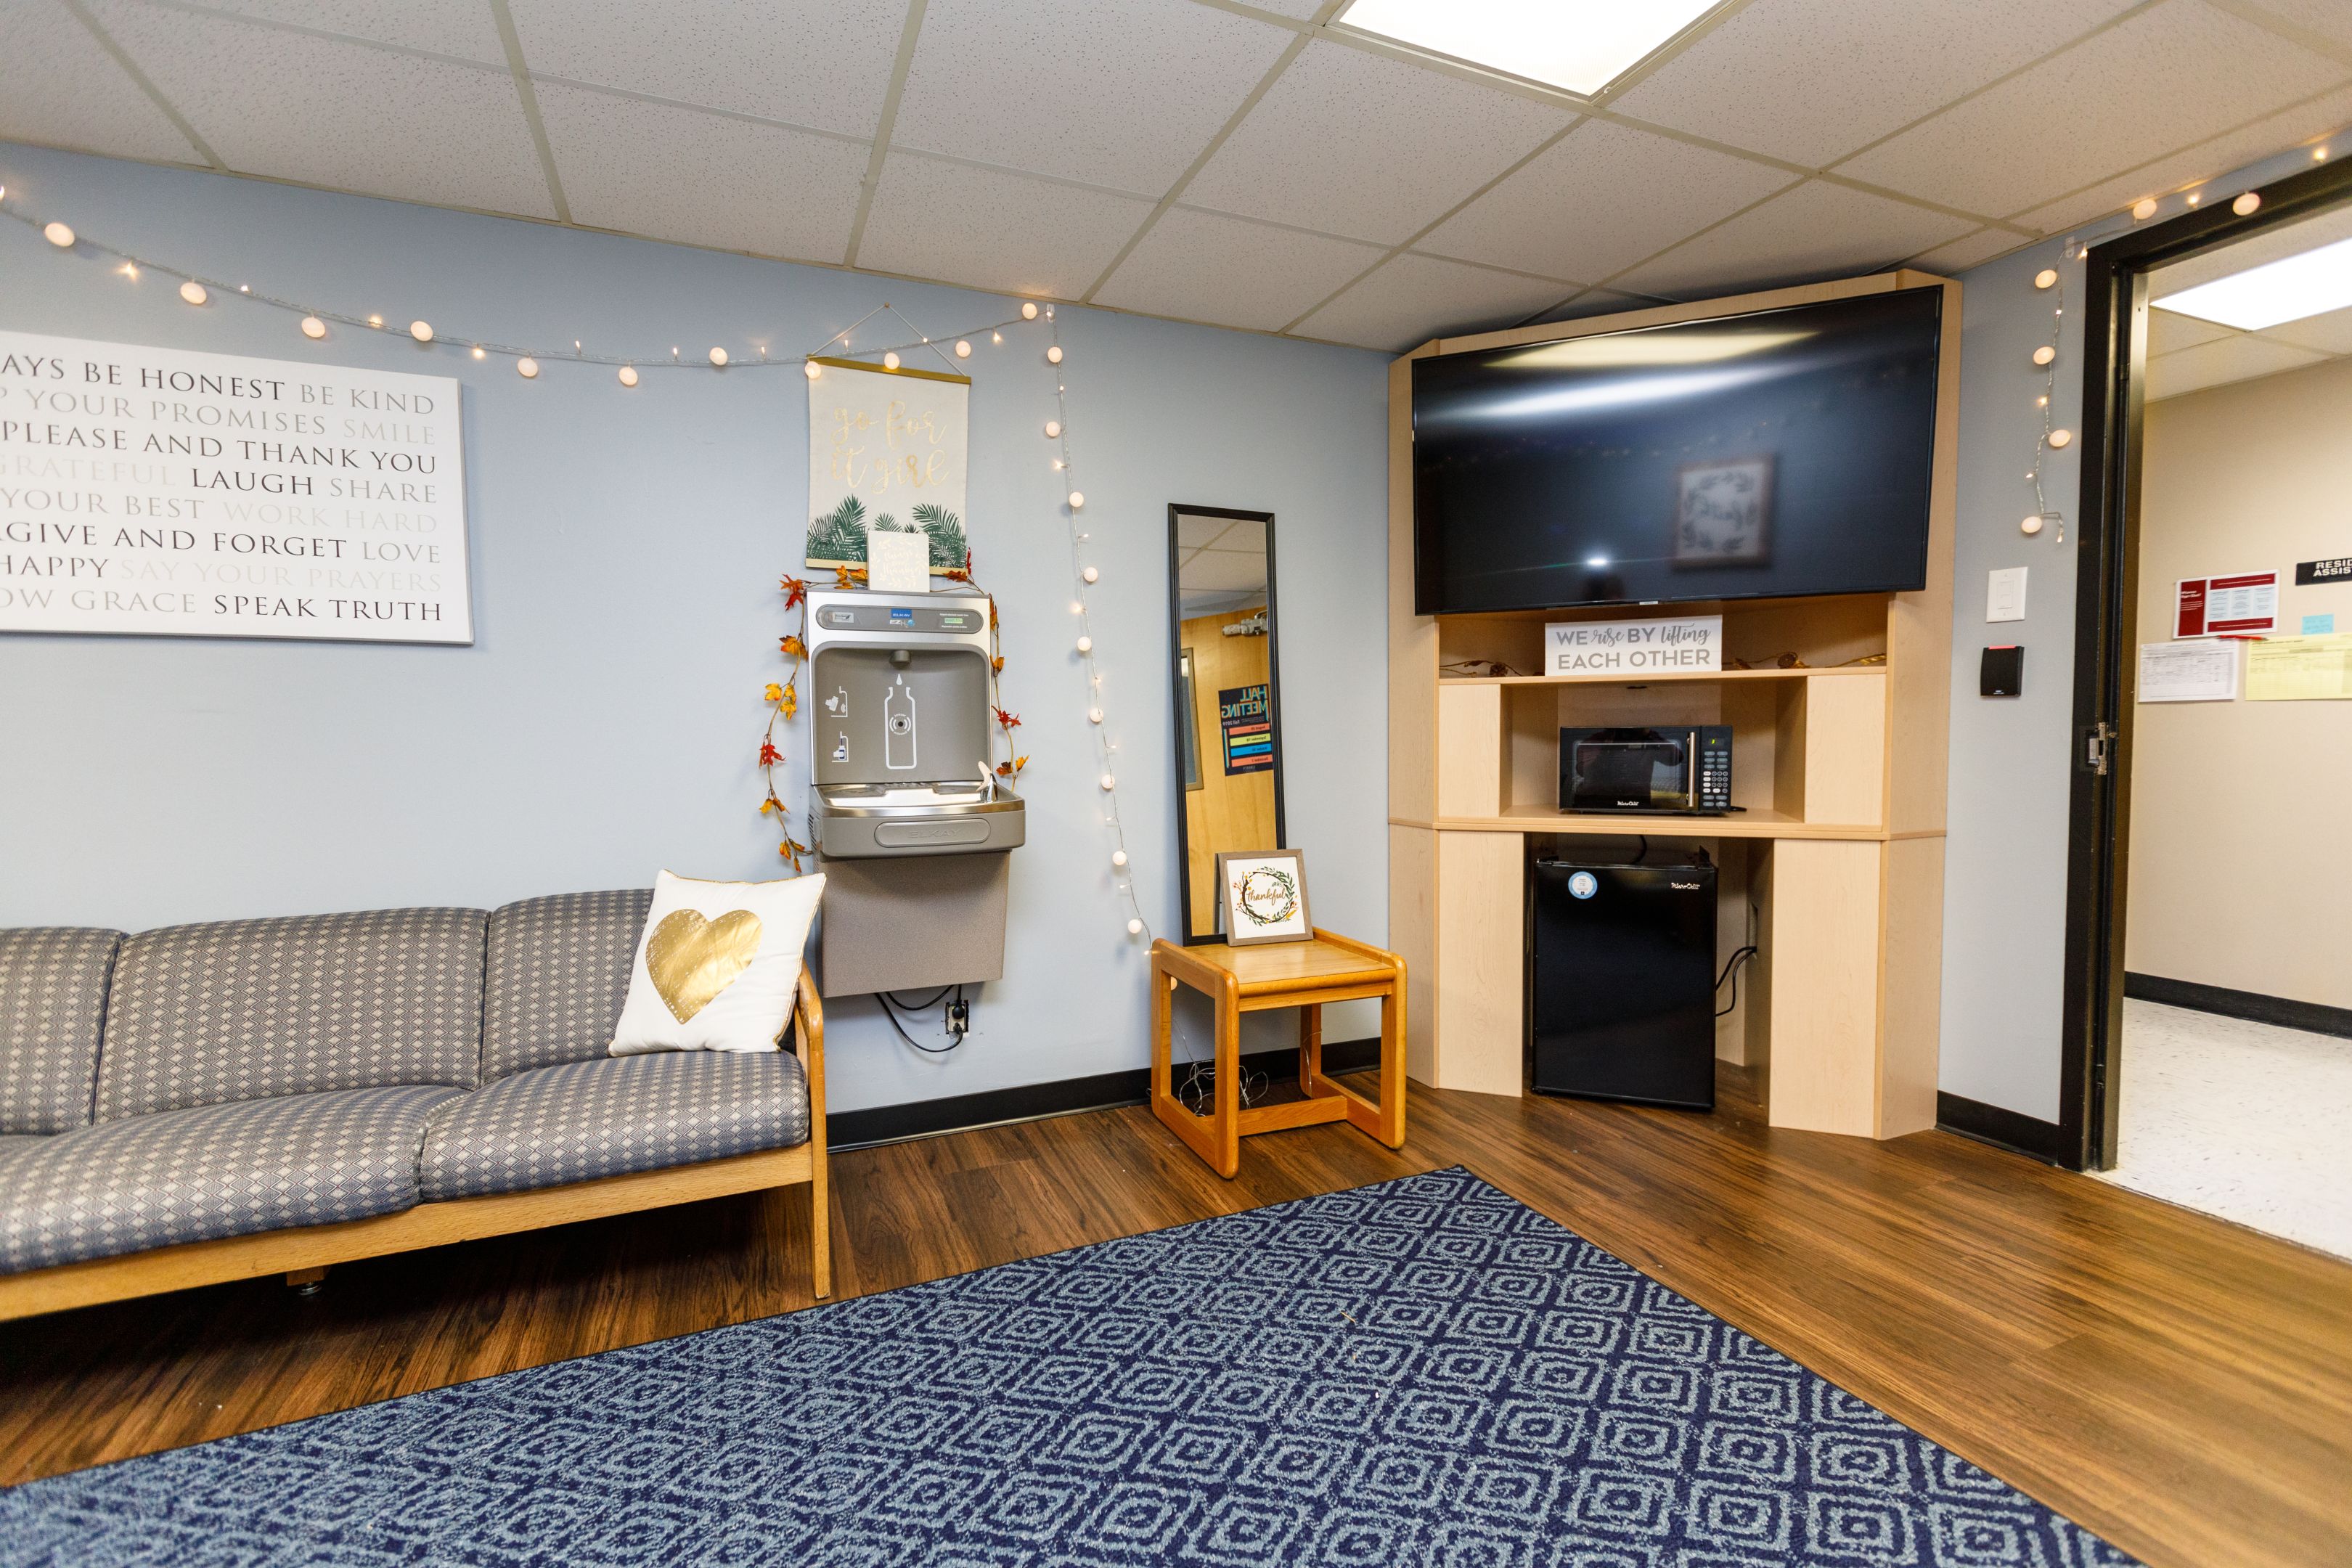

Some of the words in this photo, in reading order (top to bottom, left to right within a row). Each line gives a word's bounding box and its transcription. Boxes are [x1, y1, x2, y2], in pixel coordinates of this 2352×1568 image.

[83, 362, 123, 385] BE
[139, 367, 285, 401] HONEST
[301, 384, 335, 406] BE
[350, 388, 435, 415] KIND
[24, 389, 135, 419] YOUR
[150, 401, 327, 436] PROMISES
[343, 418, 436, 445] SMILE
[3, 420, 128, 450] PLEASE
[143, 433, 224, 457] AND
[237, 440, 362, 469] THANK
[369, 451, 436, 475] YOU
[0, 454, 176, 486] RATEFUL
[192, 468, 313, 496] LAUGH
[330, 478, 437, 503] SHARE
[0, 488, 110, 514] YOUR
[126, 495, 205, 520] BEST
[224, 502, 330, 527] WORK
[344, 509, 437, 534] HARD
[0, 521, 97, 546] GIVE
[114, 527, 196, 551] AND
[213, 532, 347, 558] FORGET
[362, 541, 441, 564] LOVE
[121, 558, 181, 581] SAY
[193, 563, 292, 587] YOUR
[308, 568, 441, 592] PRAYERS
[2313, 566, 2352, 577] ASSIS
[72, 589, 197, 613] GRACE
[214, 595, 319, 618] SPEAK
[329, 599, 441, 622] TRUTH
[1556, 630, 1588, 645] WE
[1591, 628, 1625, 647] rise
[1628, 627, 1656, 643] BY
[1661, 623, 1711, 646] lifting
[1558, 653, 1620, 669] EACH
[1629, 649, 1710, 667] OTHER
[1246, 888, 1286, 906] thankful
